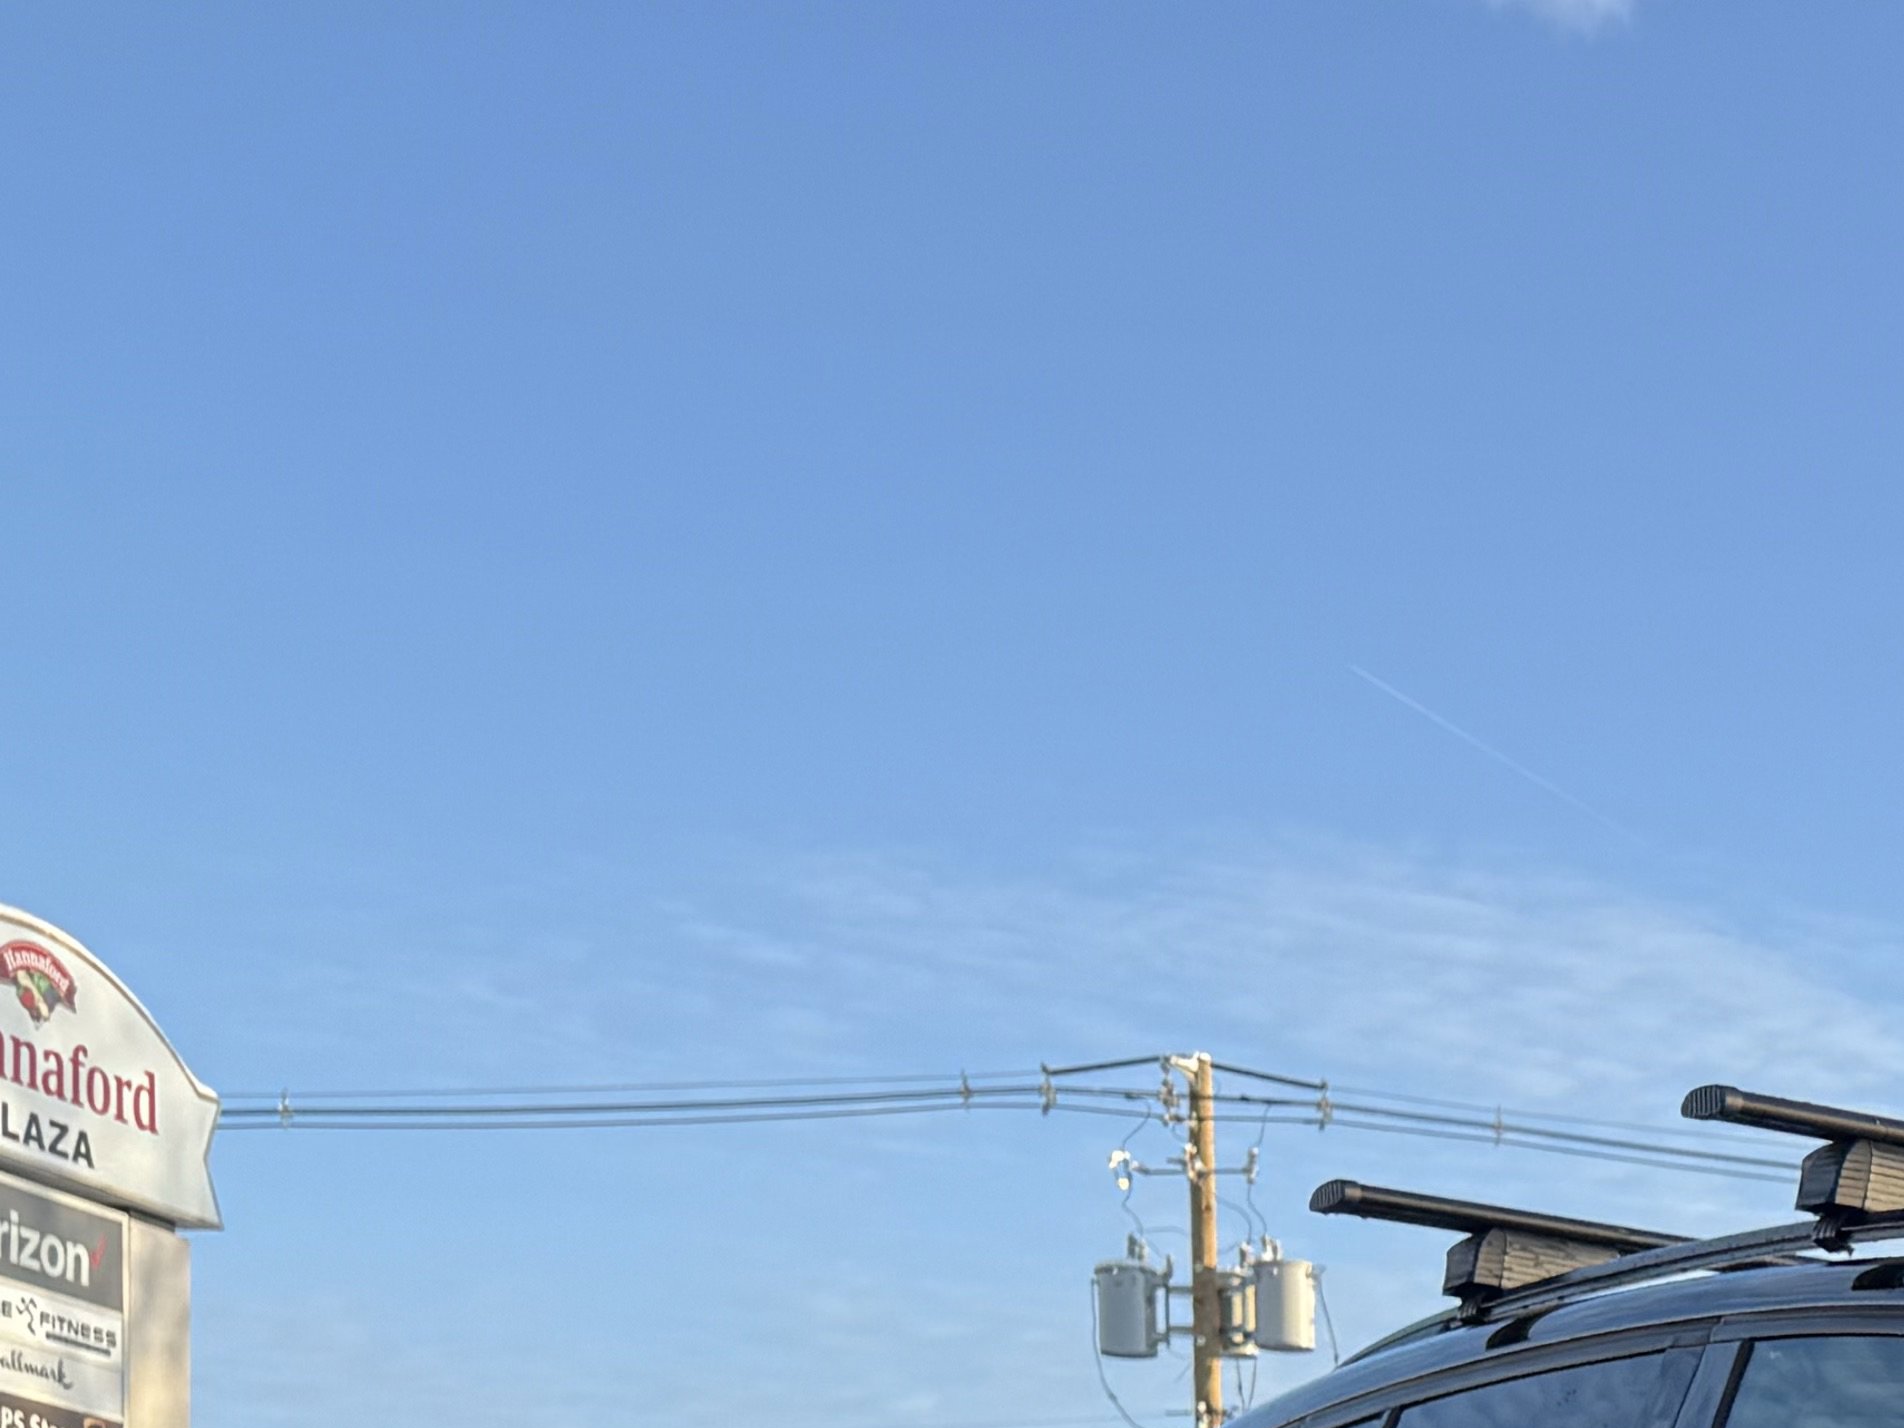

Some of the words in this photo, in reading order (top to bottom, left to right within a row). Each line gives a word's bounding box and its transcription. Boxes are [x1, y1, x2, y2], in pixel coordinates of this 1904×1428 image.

[0, 1030, 159, 1136] naford
[2, 1101, 95, 1169] LAZA
[40, 1310, 117, 1348] FITNESS
